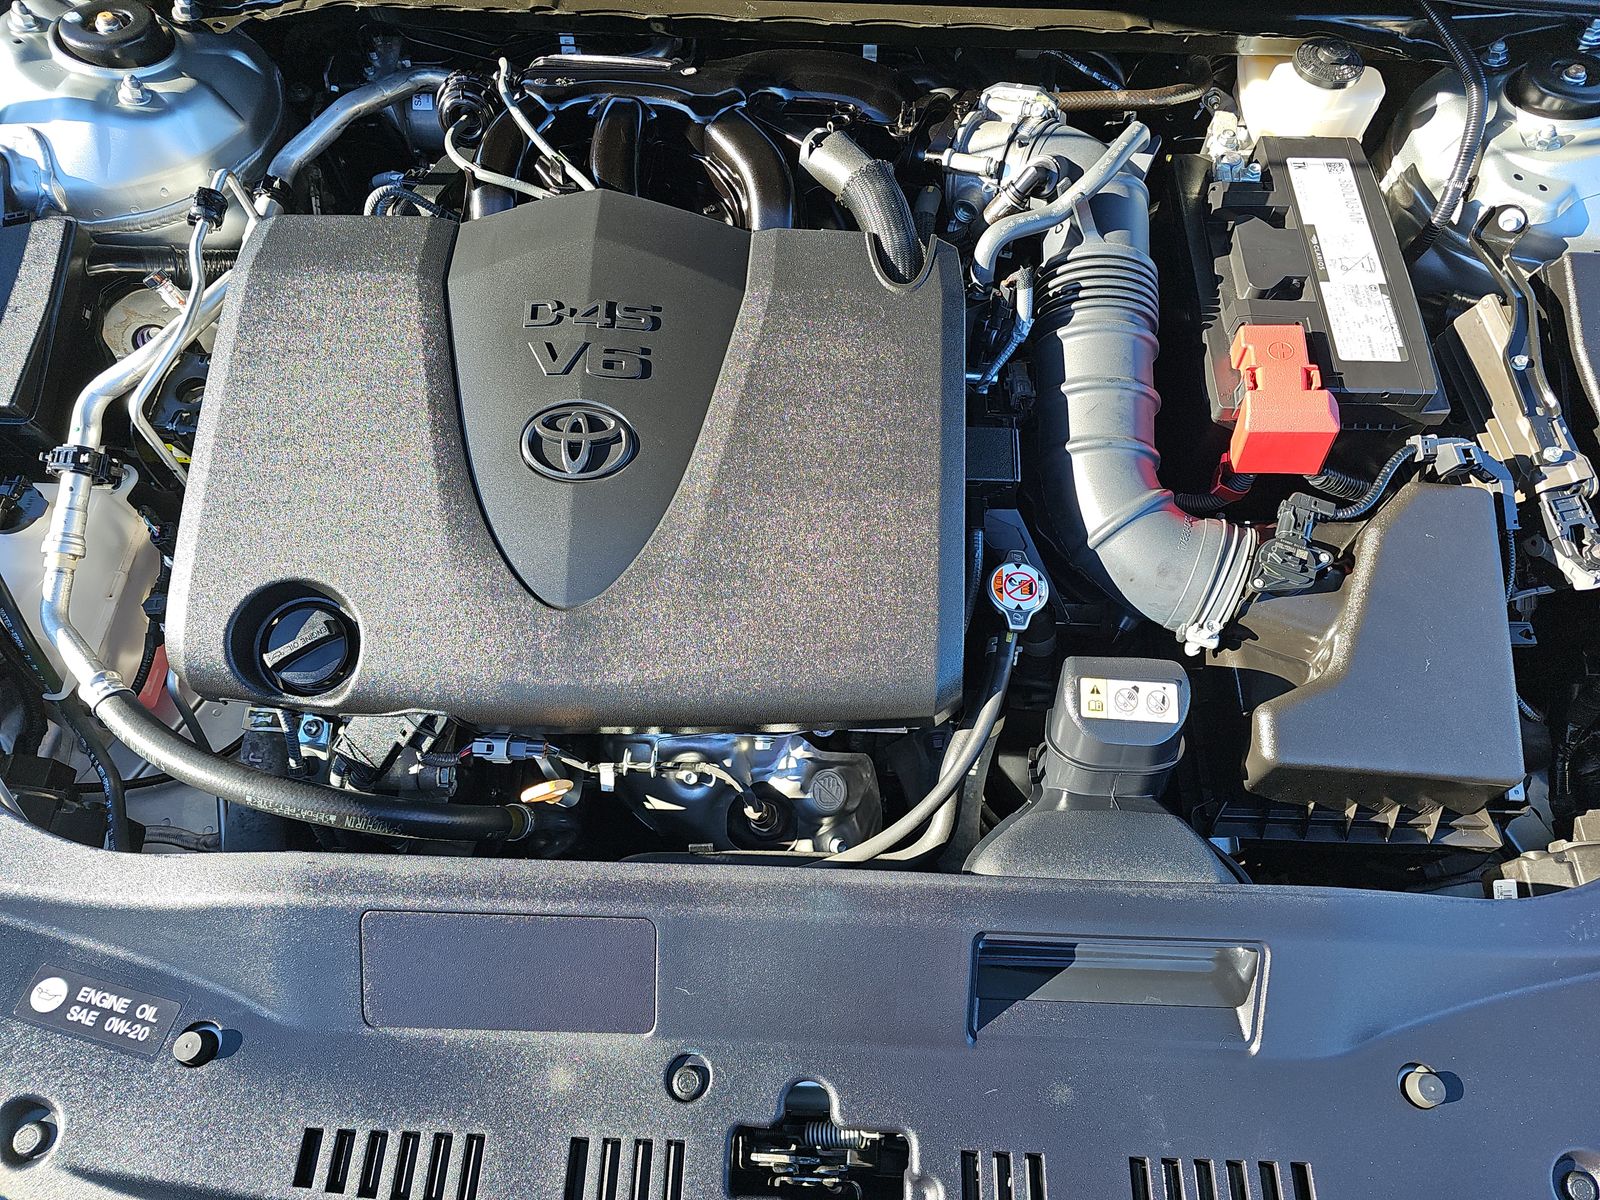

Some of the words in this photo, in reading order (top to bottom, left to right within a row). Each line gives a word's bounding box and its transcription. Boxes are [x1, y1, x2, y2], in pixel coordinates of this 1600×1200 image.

[1313, 244, 1326, 270] CLARIOS
[528, 341, 653, 380] V6
[288, 640, 300, 653] OIL
[300, 626, 328, 645] ENGINE
[76, 986, 132, 1014] ENGINE
[136, 1004, 159, 1023] OIL
[66, 1005, 100, 1027] SAE
[104, 1016, 150, 1042] 0W-20
